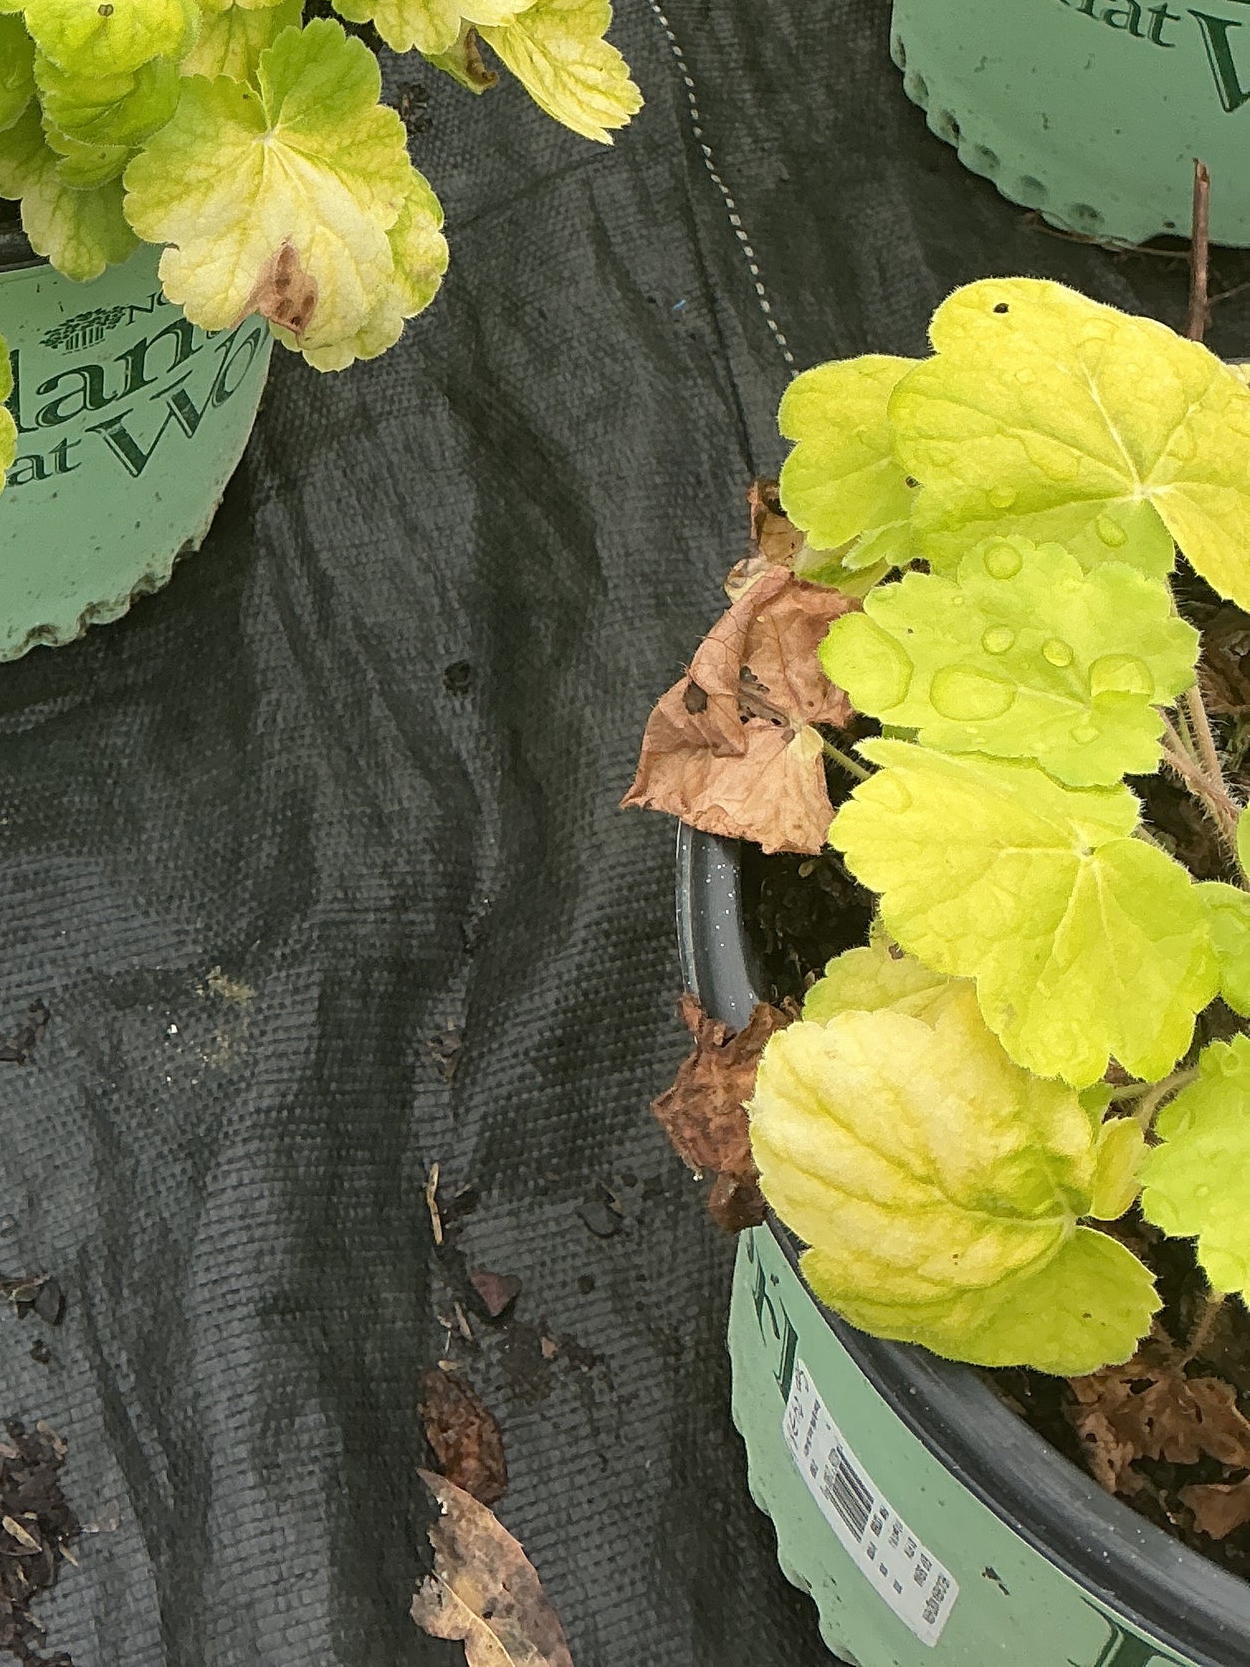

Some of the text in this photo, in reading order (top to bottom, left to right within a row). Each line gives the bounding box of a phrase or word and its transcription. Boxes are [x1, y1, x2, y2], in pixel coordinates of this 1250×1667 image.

[2, 316, 218, 435] lan
[5, 318, 266, 487] at Wo
